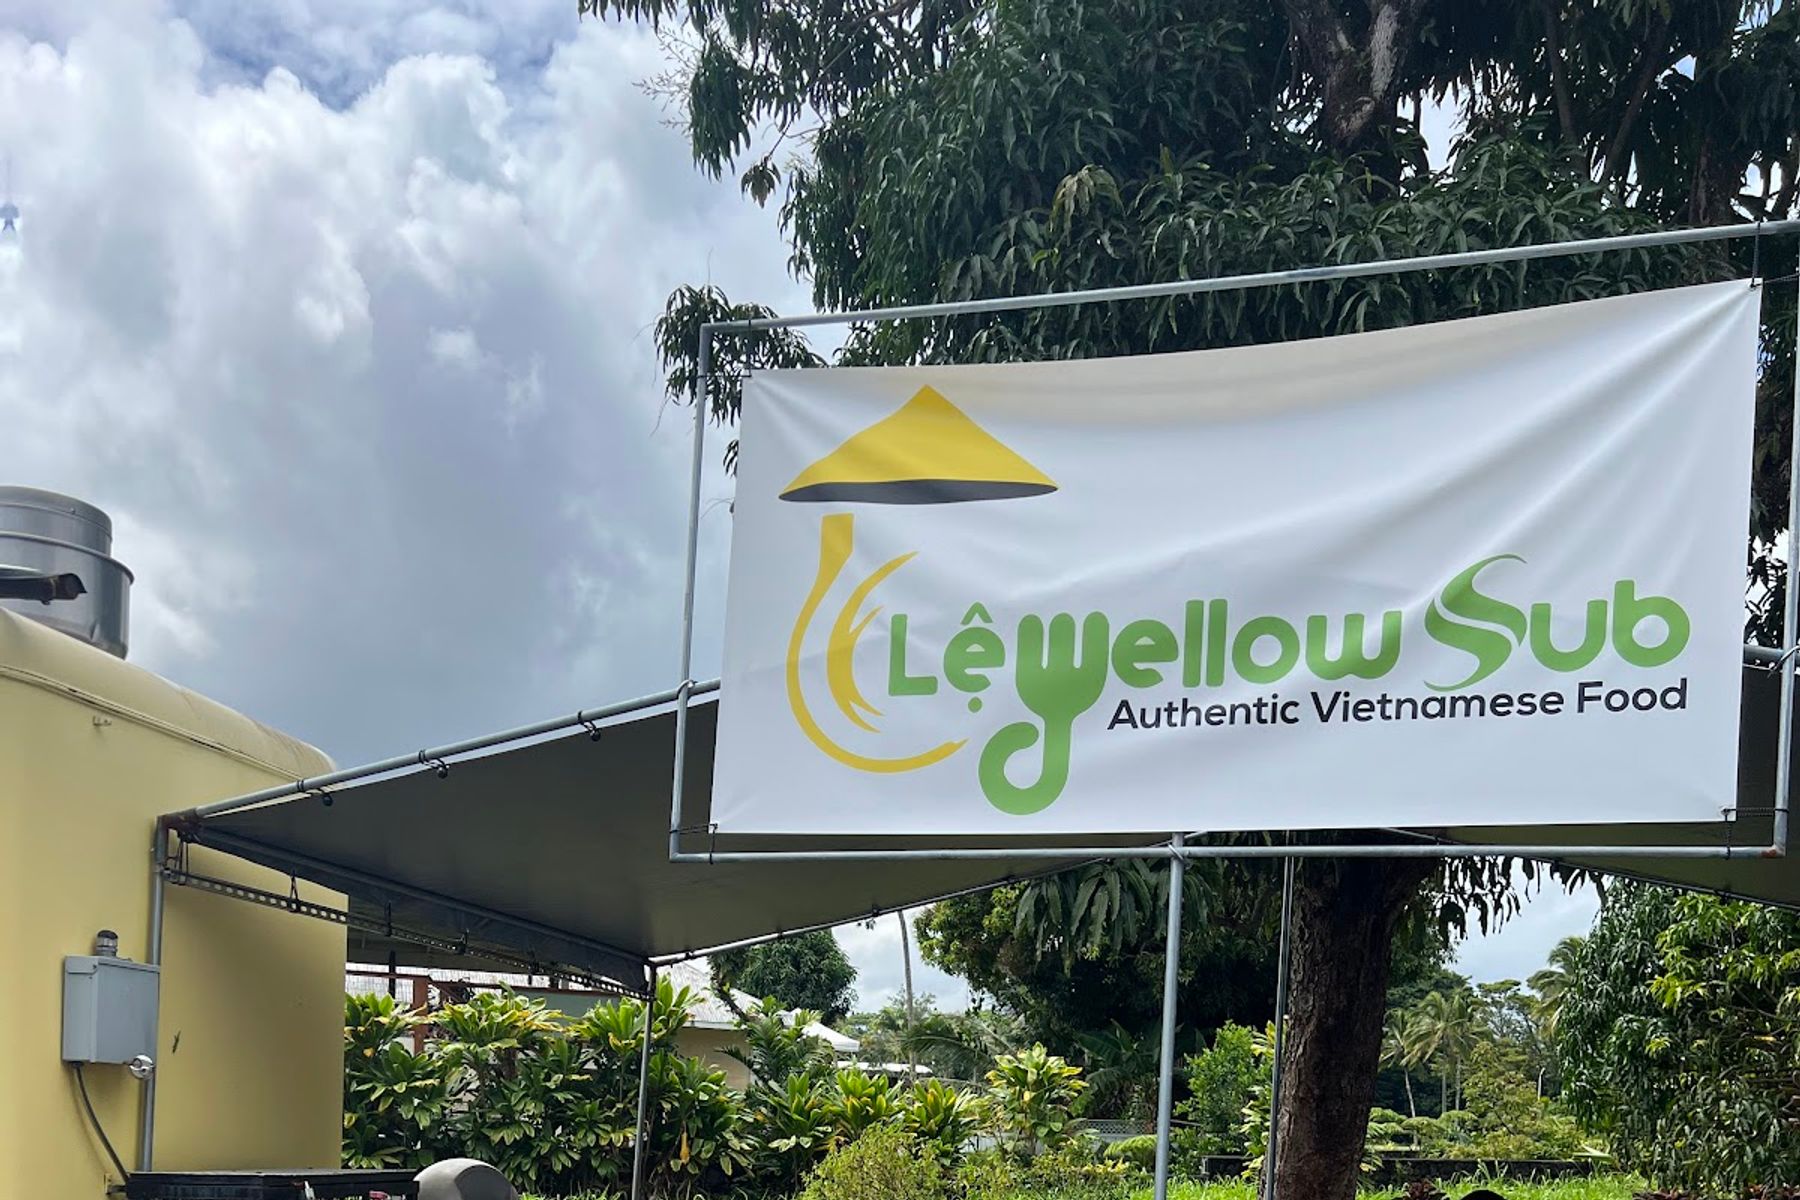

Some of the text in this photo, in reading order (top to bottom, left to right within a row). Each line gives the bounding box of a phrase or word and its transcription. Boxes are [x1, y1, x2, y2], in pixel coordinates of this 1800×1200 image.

[1423, 553, 1691, 692] Sub
[1107, 677, 1689, 731] Authentic Vietnamese Food
